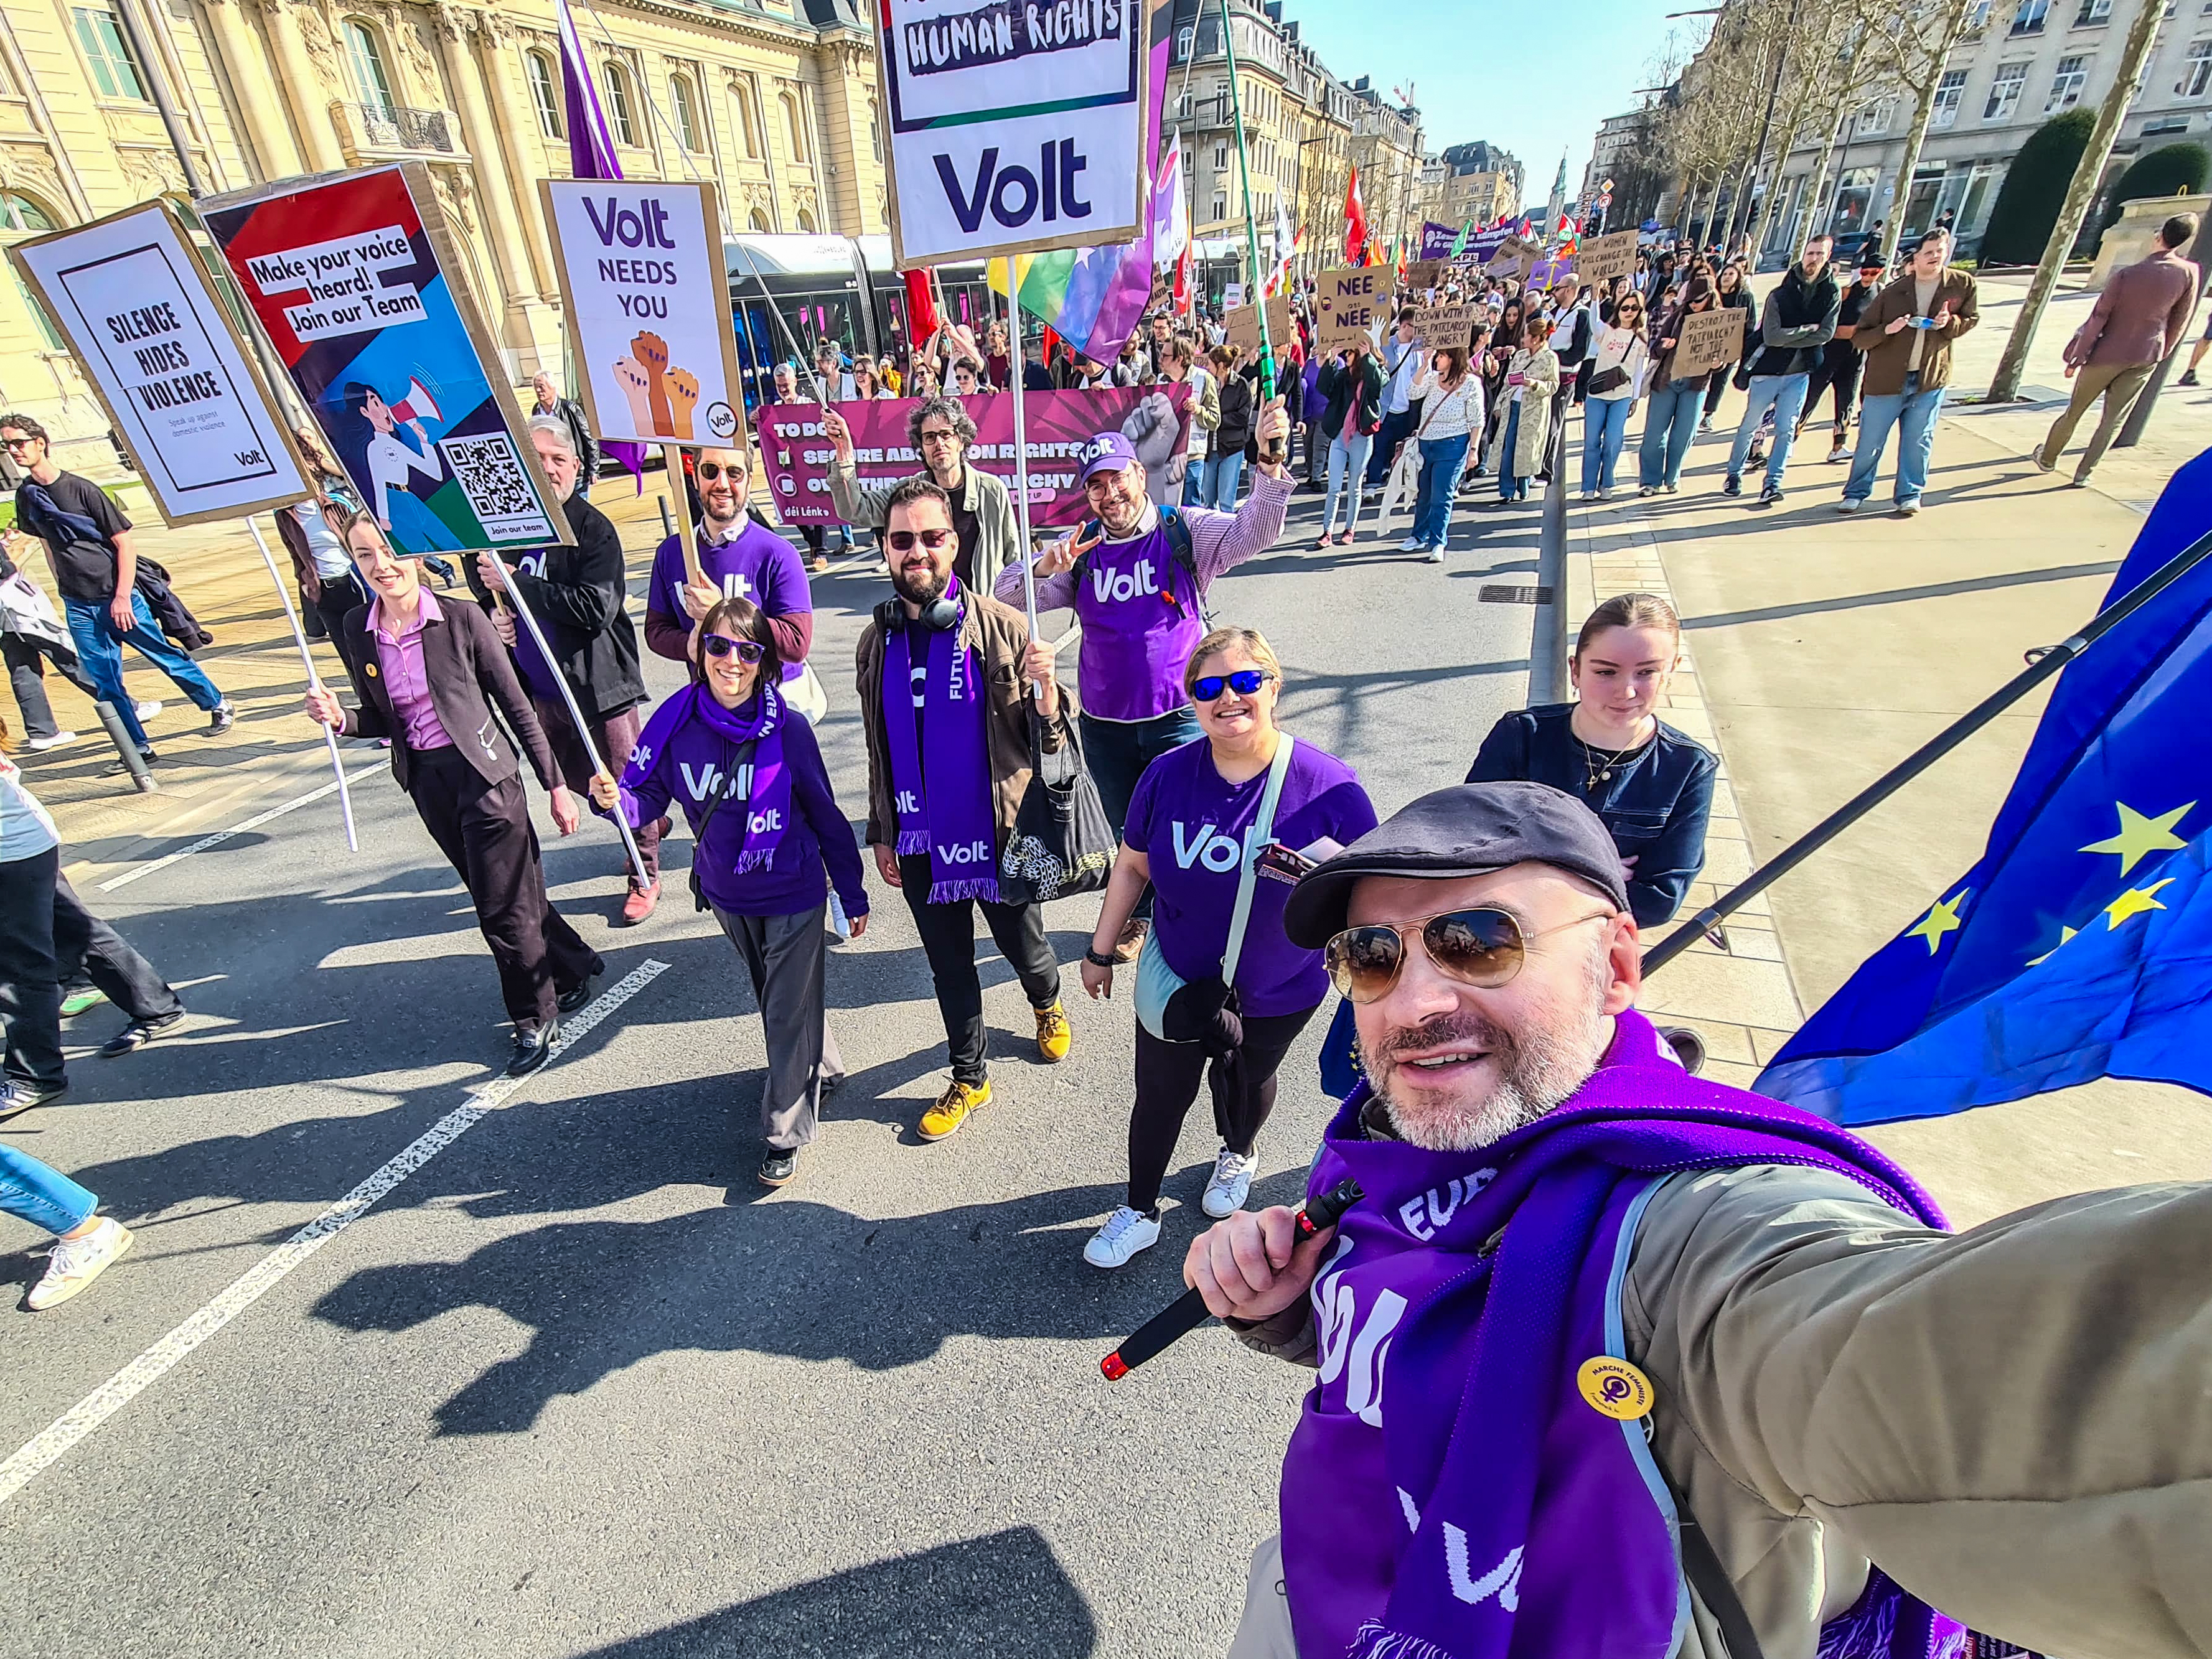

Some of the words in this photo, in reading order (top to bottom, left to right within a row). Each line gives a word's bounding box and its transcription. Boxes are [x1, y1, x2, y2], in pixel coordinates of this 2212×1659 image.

[907, 12, 1014, 67] HUMAN
[1026, 0, 1120, 50] RIGHTS
[932, 136, 1092, 233] Volt
[581, 197, 676, 249] Volt
[250, 255, 306, 284] Make
[307, 250, 351, 279] your
[354, 233, 408, 261] voice
[1596, 250, 1621, 262] CHANGE
[598, 258, 677, 285] NEEDS
[306, 266, 374, 301] heard!
[1337, 275, 1374, 296] NEE
[289, 307, 330, 332] Join
[332, 305, 362, 325] our
[362, 294, 421, 317] Team
[617, 294, 668, 319] YOU
[1415, 310, 1440, 322] DOWN
[1443, 308, 1463, 319] WITH
[106, 302, 181, 343] SILENCE
[1336, 307, 1371, 327] NEE
[1689, 314, 1725, 330] DESTROY
[1414, 325, 1427, 335] THE
[1422, 336, 1432, 348] BE
[1435, 332, 1466, 345] ANGRY
[1686, 325, 1735, 344] PATRIARCHY
[134, 341, 190, 376] HIDES
[138, 371, 222, 411] VIOLENCE
[168, 418, 186, 428] Speak
[197, 411, 218, 422] against
[199, 421, 226, 431] violence
[711, 413, 733, 428] Volt
[774, 423, 800, 437] TO
[234, 450, 265, 466] Volt
[1000, 442, 1085, 459] RGHTS
[1079, 437, 1117, 465] Volt
[801, 506, 824, 516] Lénk
[492, 526, 508, 535] Join
[508, 525, 522, 533] our
[523, 523, 543, 531] team
[1093, 558, 1159, 603] Volt
[758, 720, 775, 737] IN
[937, 841, 989, 865] Volt
[1592, 1365, 1624, 1376] MARCHE
[1626, 1372, 1645, 1406] FEMINISTE
